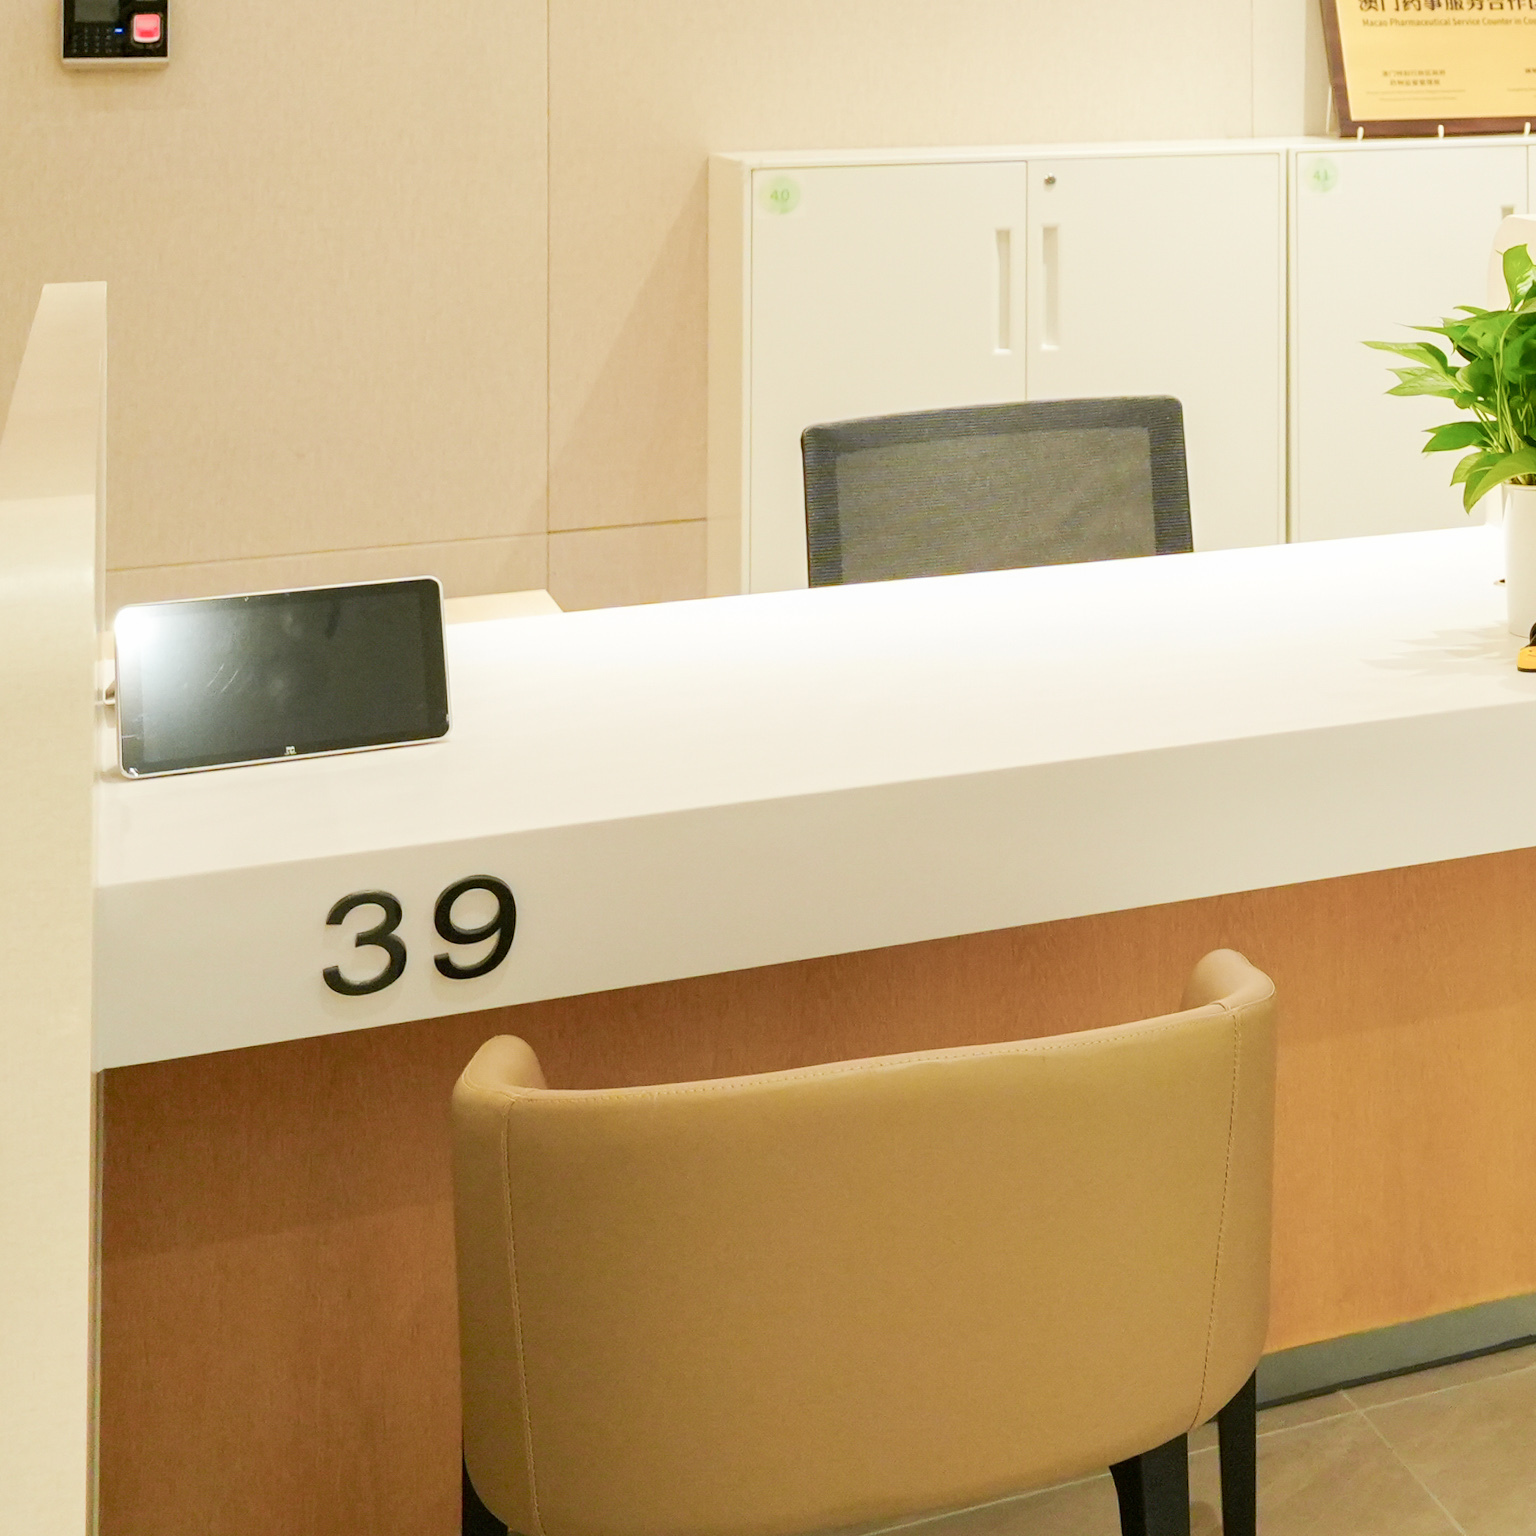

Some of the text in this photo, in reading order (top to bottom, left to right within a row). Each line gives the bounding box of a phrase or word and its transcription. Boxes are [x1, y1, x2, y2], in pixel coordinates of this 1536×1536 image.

[1452, 16, 1481, 26] Service
[1481, 16, 1513, 26] Counter
[770, 188, 791, 202] 40
[322, 874, 517, 996] 39
